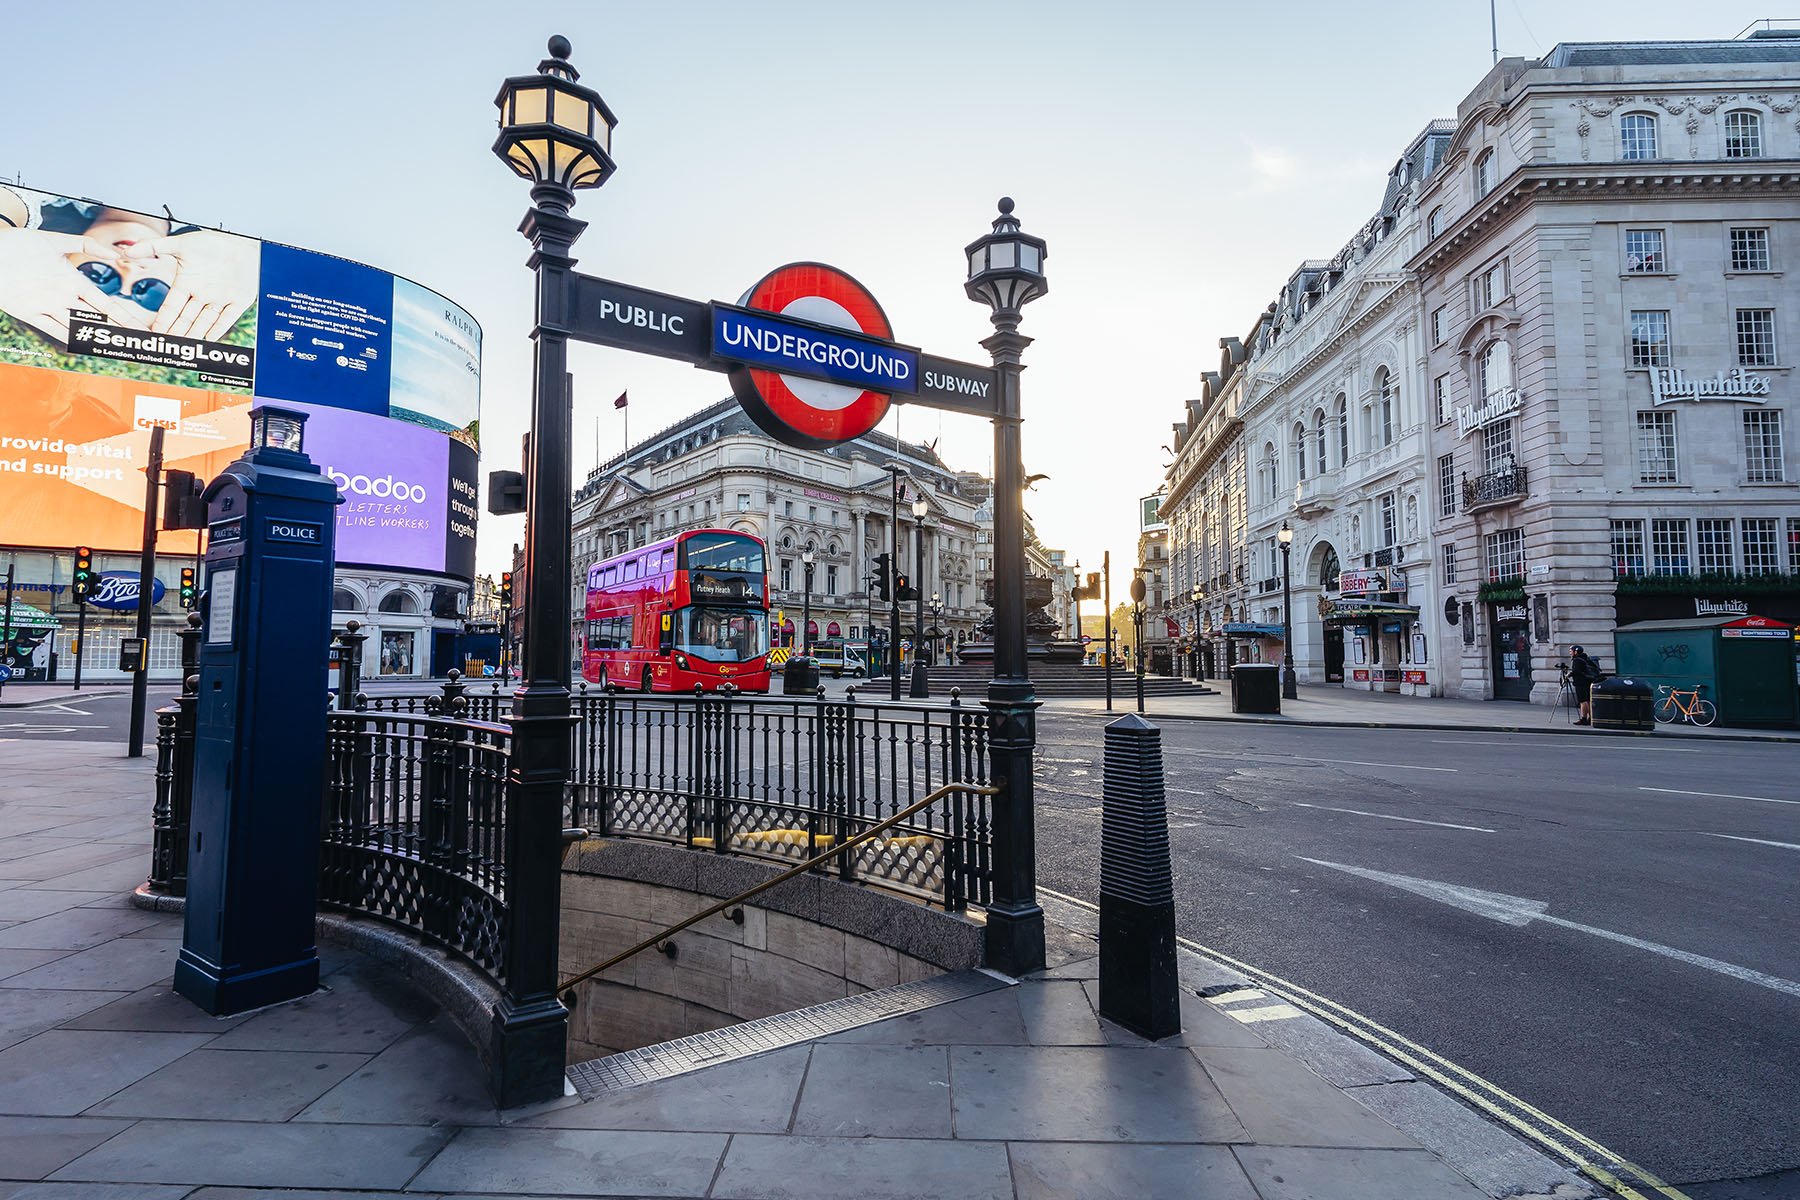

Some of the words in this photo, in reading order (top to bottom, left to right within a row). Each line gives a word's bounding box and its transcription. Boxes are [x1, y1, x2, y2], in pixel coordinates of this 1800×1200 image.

[445, 310, 473, 337] RALPH
[75, 325, 250, 366] #SendingLove
[600, 299, 684, 336] PUBLIC
[722, 320, 909, 380] UNDERGROUND
[925, 371, 990, 398] SUBWAY
[103, 348, 136, 361] London,
[136, 353, 163, 363] United
[163, 357, 198, 369] Kingdom
[207, 376, 224, 384] from
[224, 377, 250, 388] Estonia
[1649, 365, 1772, 407] Lillywhites
[83, 443, 133, 460] vital
[32, 462, 124, 481] support
[327, 466, 427, 504] badoo
[348, 502, 408, 515] LETTERS
[272, 525, 315, 539] POLICE
[380, 517, 430, 529] WORKERS
[697, 584, 714, 594] Putney
[742, 585, 754, 597] 14
[1694, 598, 1748, 616] Lillywhites
